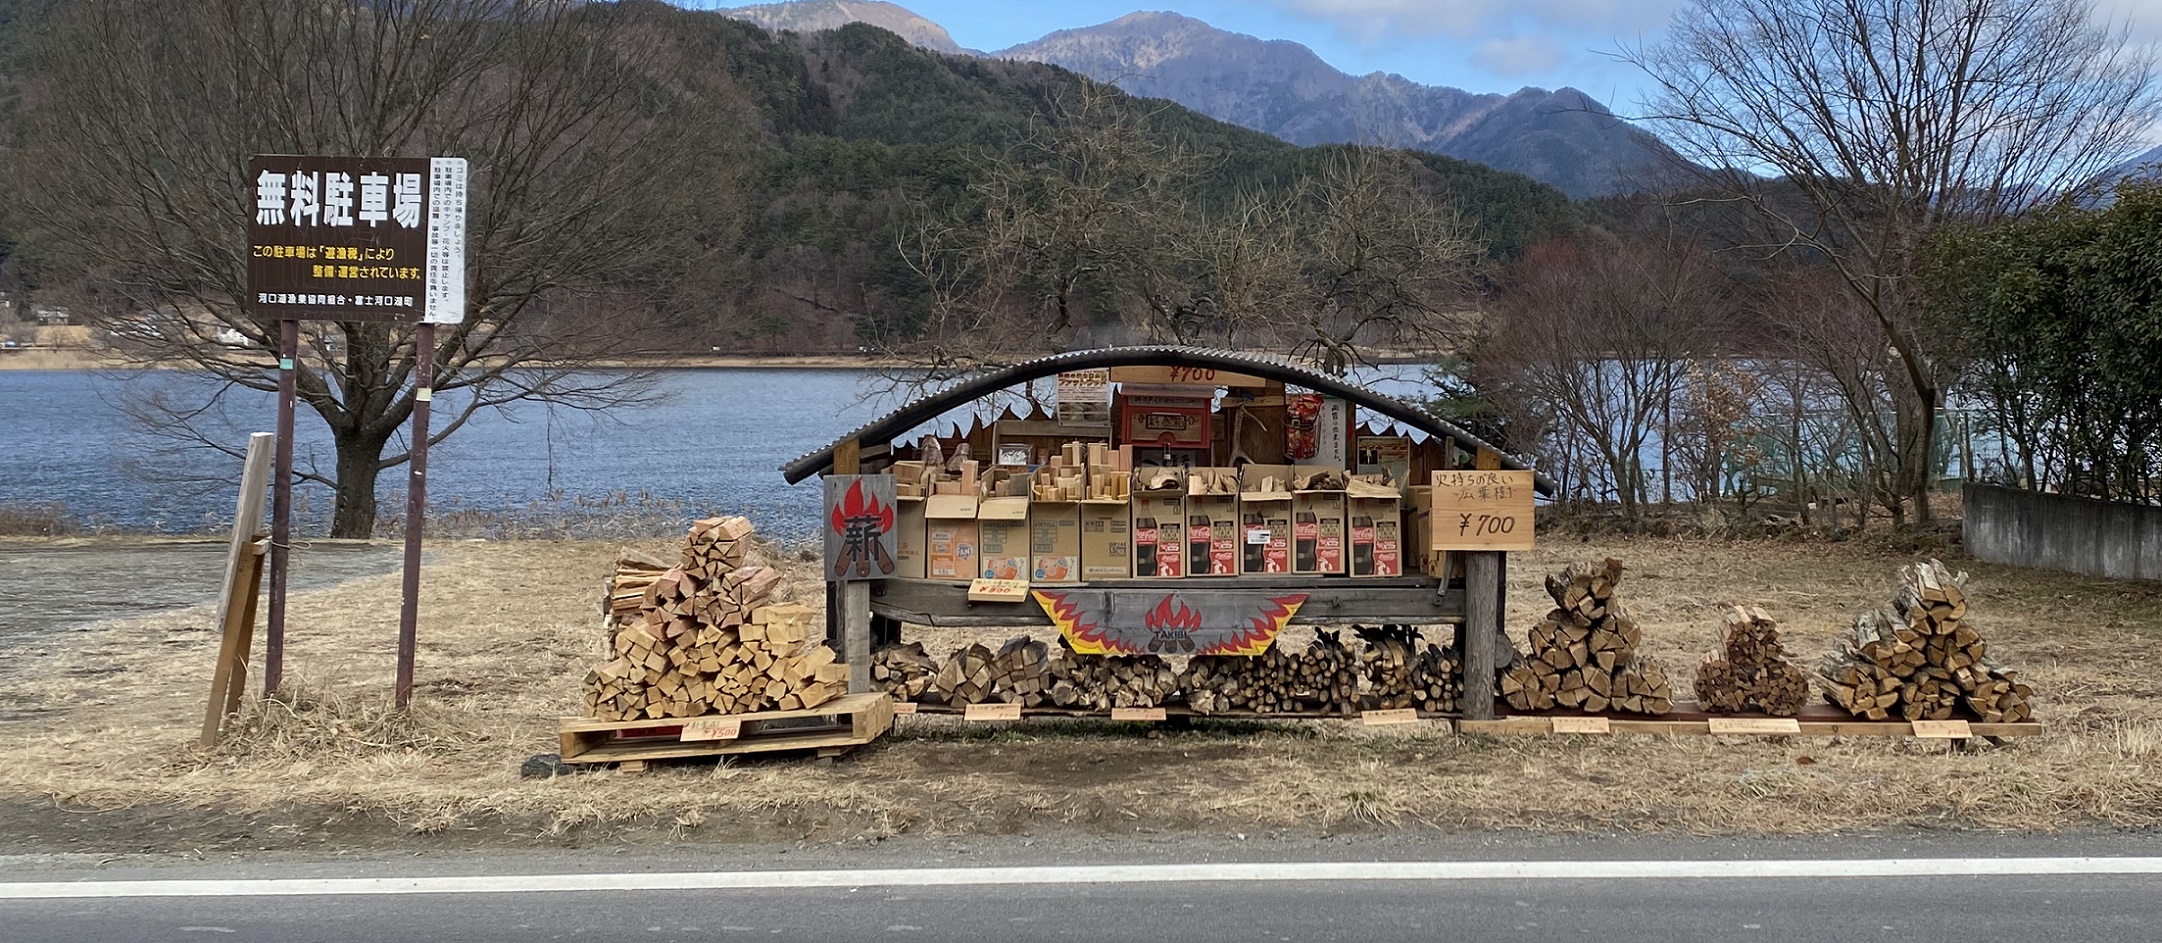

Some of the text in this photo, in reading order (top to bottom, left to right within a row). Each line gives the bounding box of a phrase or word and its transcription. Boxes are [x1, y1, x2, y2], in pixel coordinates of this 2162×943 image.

[256, 169, 422, 229] 無料駐車場
[1170, 366, 1215, 382] ¥700
[1436, 472, 1514, 487] 火持ちの良い
[1454, 486, 1516, 501] 広葉樹
[1459, 513, 1516, 537] ¥700
[844, 514, 882, 562] 薪
[1153, 630, 1187, 640] TAKIBI
